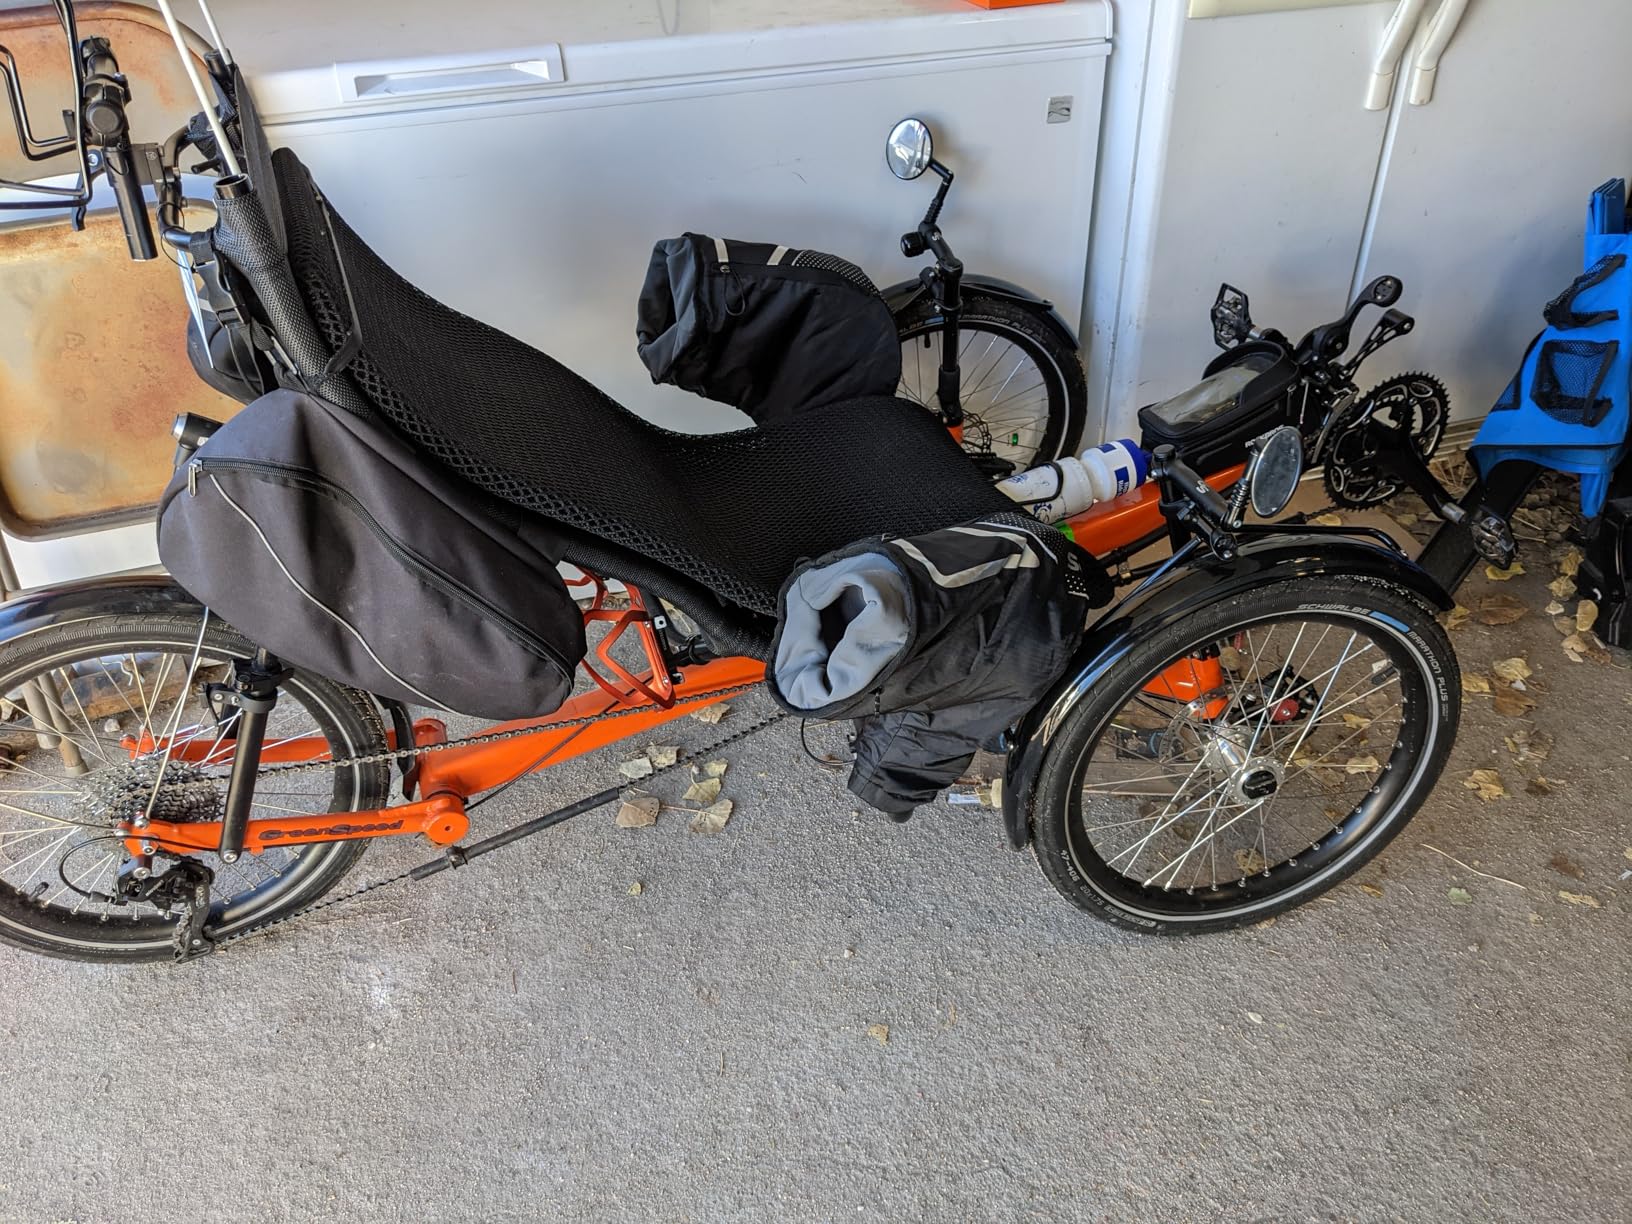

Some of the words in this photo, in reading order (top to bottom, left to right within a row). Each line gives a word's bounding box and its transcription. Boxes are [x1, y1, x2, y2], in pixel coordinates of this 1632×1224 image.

[963, 314, 1010, 324] MARATHON
[1012, 322, 1033, 334] PLUS
[1245, 425, 1284, 448] ROKBROS
[1296, 603, 1371, 615] SCHWALBE
[1407, 631, 1442, 674] MARATHON
[1436, 676, 1449, 702] PLUS
[258, 819, 404, 841] GreenSpeed
[1061, 850, 1080, 881] 47-406
